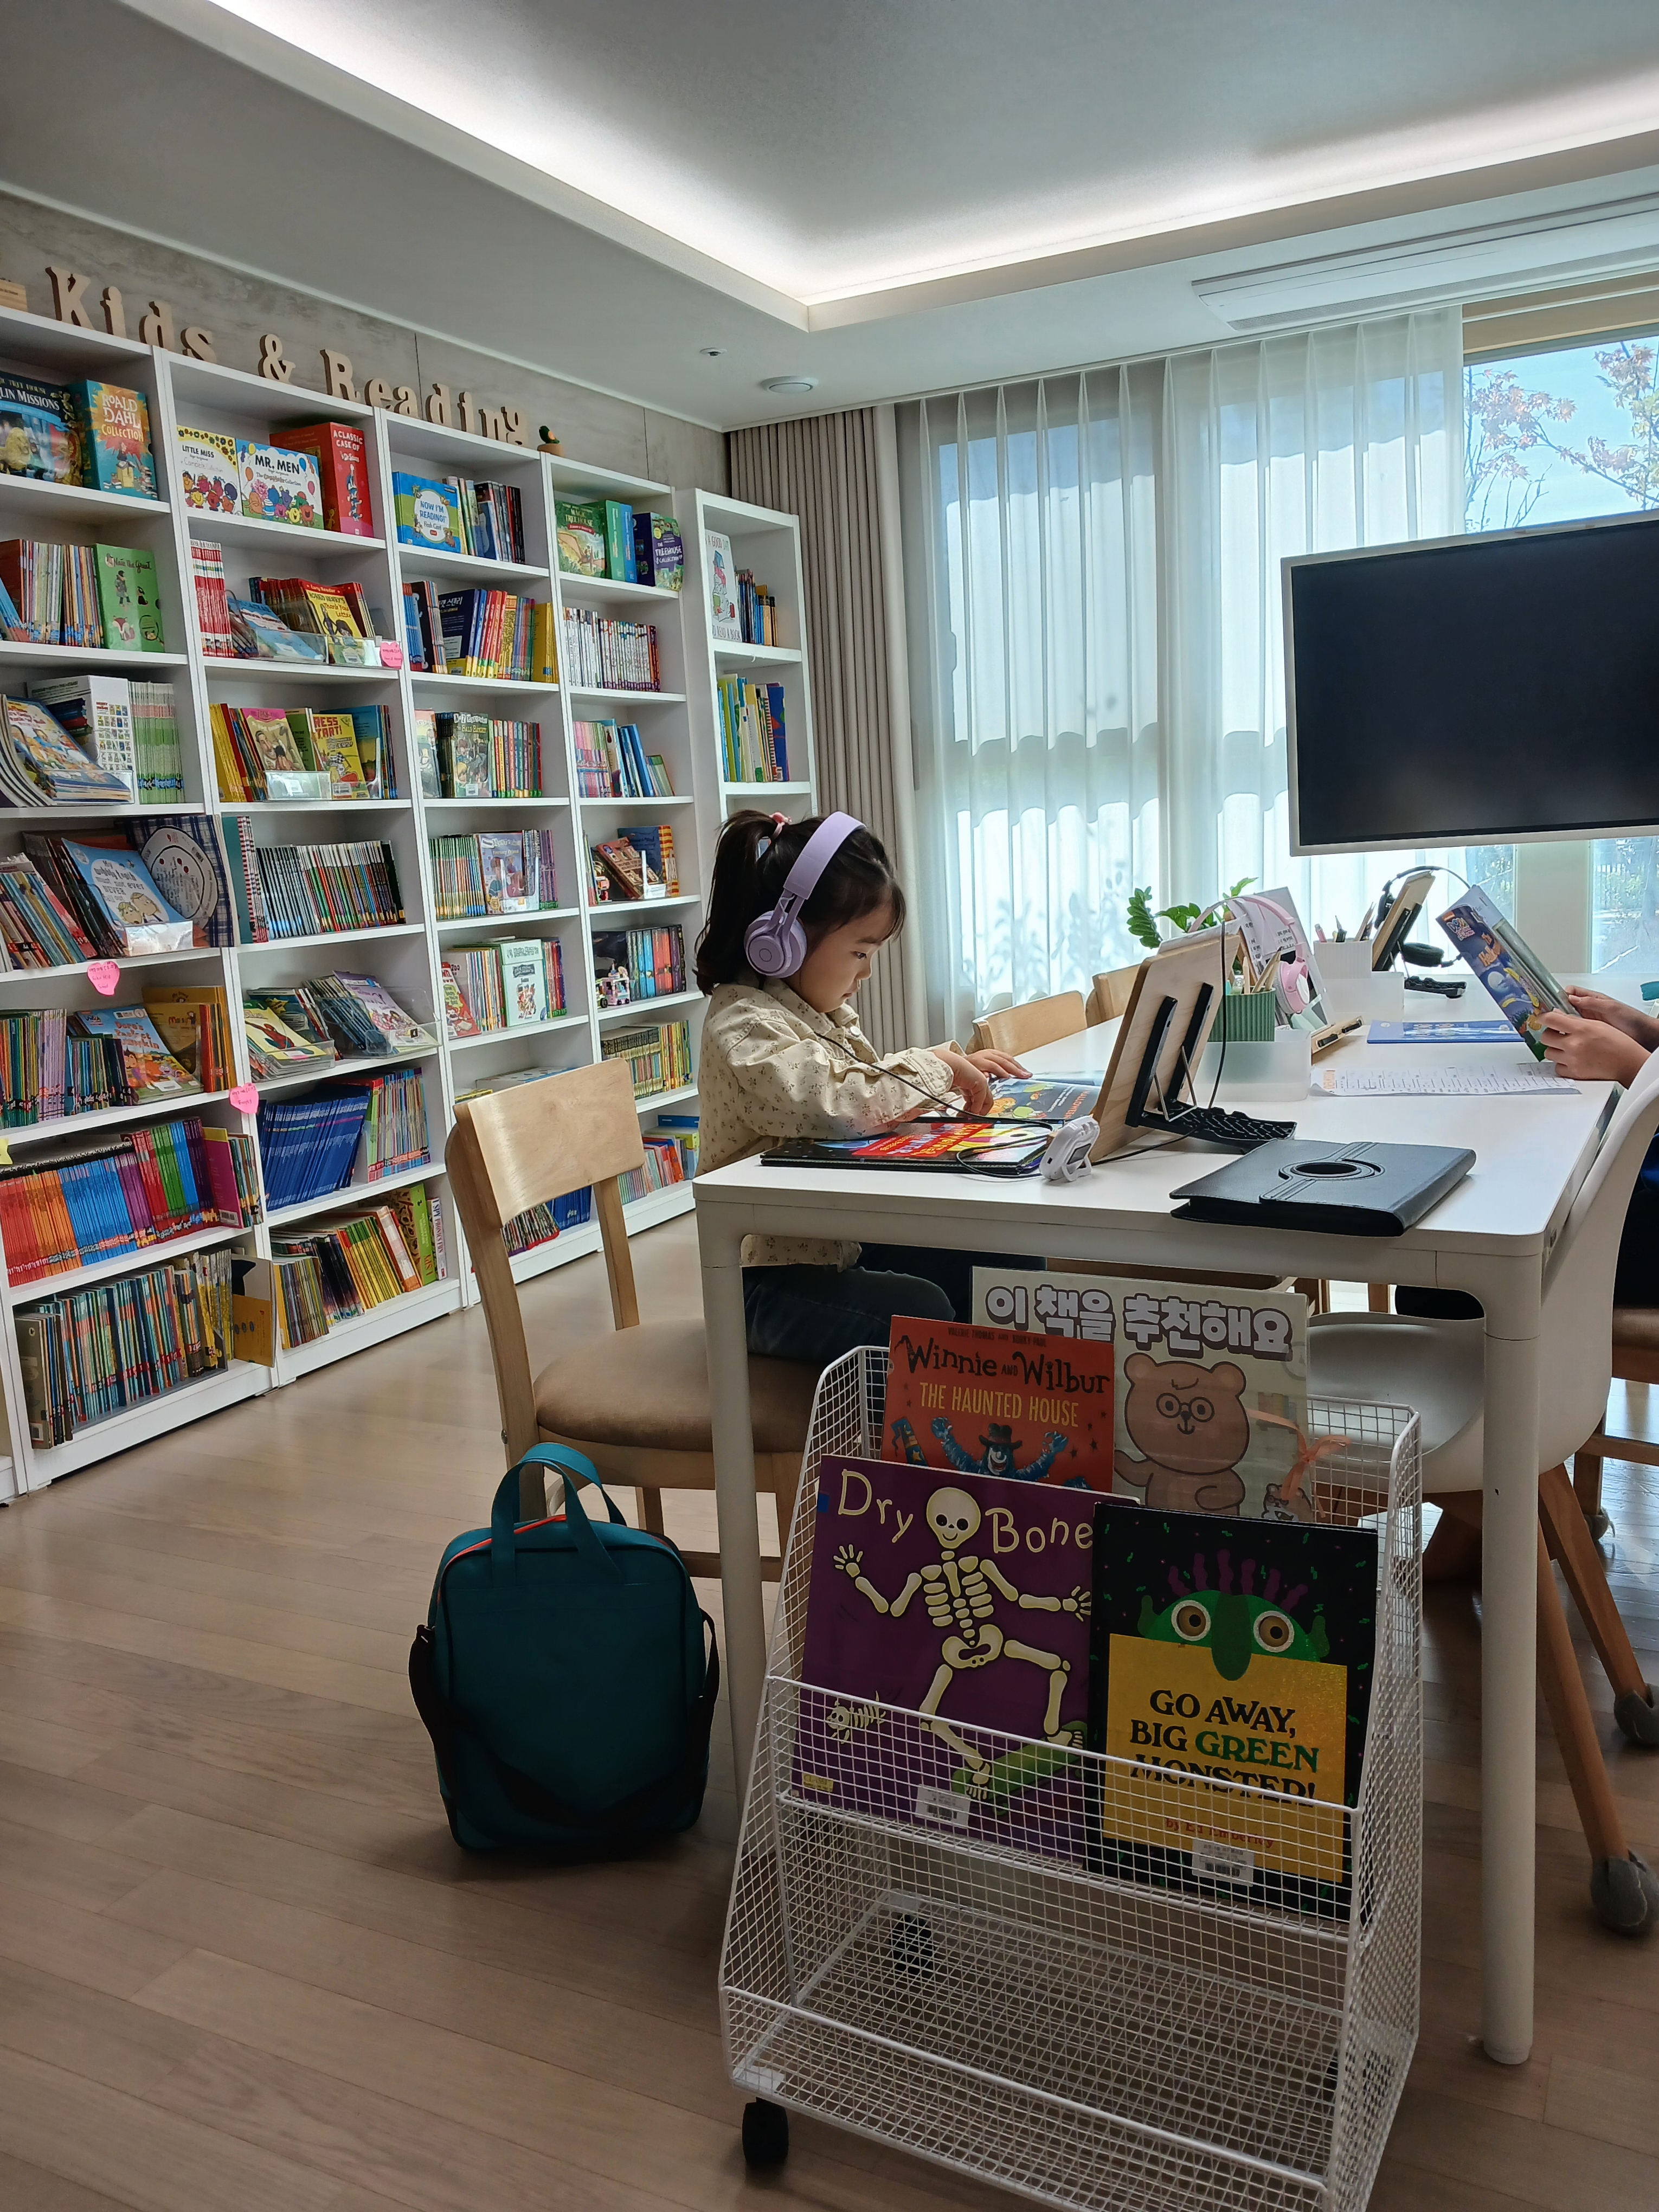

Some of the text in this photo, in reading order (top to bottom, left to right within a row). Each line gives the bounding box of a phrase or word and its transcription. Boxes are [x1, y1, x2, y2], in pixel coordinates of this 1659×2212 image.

[46, 267, 529, 446] Kids & Reading
[0, 386, 60, 411] LIN MISSIONS
[101, 393, 138, 413] ROALD
[102, 407, 142, 429] DAHL
[101, 423, 144, 442] COLLECTION
[338, 430, 364, 445] CLASSIC
[182, 445, 199, 454] LITTLE
[201, 449, 215, 458] MISS
[336, 440, 360, 452] CASE OF
[255, 455, 275, 469] MR.
[277, 459, 300, 475] MEN
[420, 500, 444, 513] NOW I'M
[420, 510, 446, 523] READING!
[313, 717, 339, 728] RESS
[315, 725, 343, 739] TART!
[102, 860, 113, 869] My
[121, 1039, 159, 1050] umpkin
[433, 1204, 441, 1217] SPY
[424, 1254, 433, 1271] SPY
[986, 1284, 1293, 1361] 이 책을 추천해요
[948, 1327, 970, 1338] VALERIE
[972, 1330, 995, 1341] THOMAS
[894, 1335, 1110, 1394] Winnie AND Wilbur
[919, 1382, 1079, 1427] THE HAUNTED HOUSE
[838, 1469, 1094, 1554] Dry Bone
[1150, 1689, 1296, 1739] GO AWAY,
[1129, 1719, 1320, 1773] BIG GREEN
[1166, 1817, 1180, 1831] by
